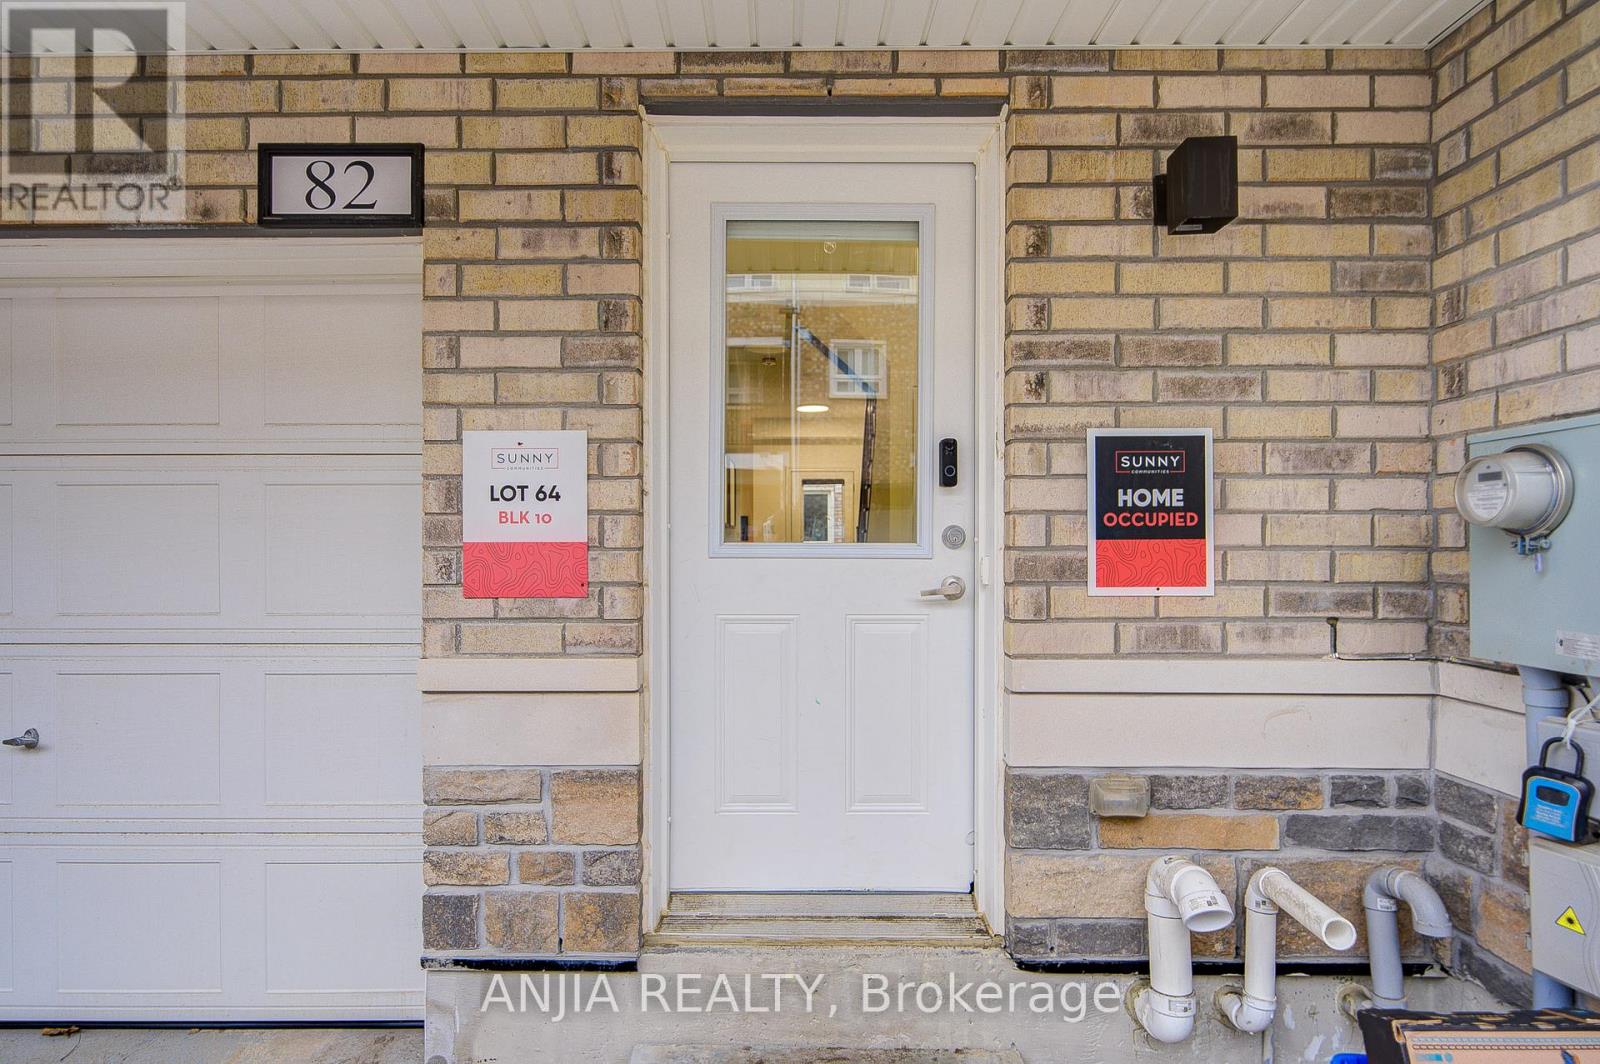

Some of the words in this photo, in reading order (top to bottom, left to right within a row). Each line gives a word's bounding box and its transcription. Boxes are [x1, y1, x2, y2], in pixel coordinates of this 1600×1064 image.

[304, 160, 378, 211] 82
[497, 453, 553, 464] SUNNY
[1121, 455, 1180, 468] SUNNY
[490, 485, 529, 502] LOT
[535, 485, 561, 502] 64
[1117, 488, 1184, 507] HOME
[498, 511, 530, 524] BLK
[535, 513, 552, 524] 10
[1103, 512, 1199, 527] OCCUPIED
